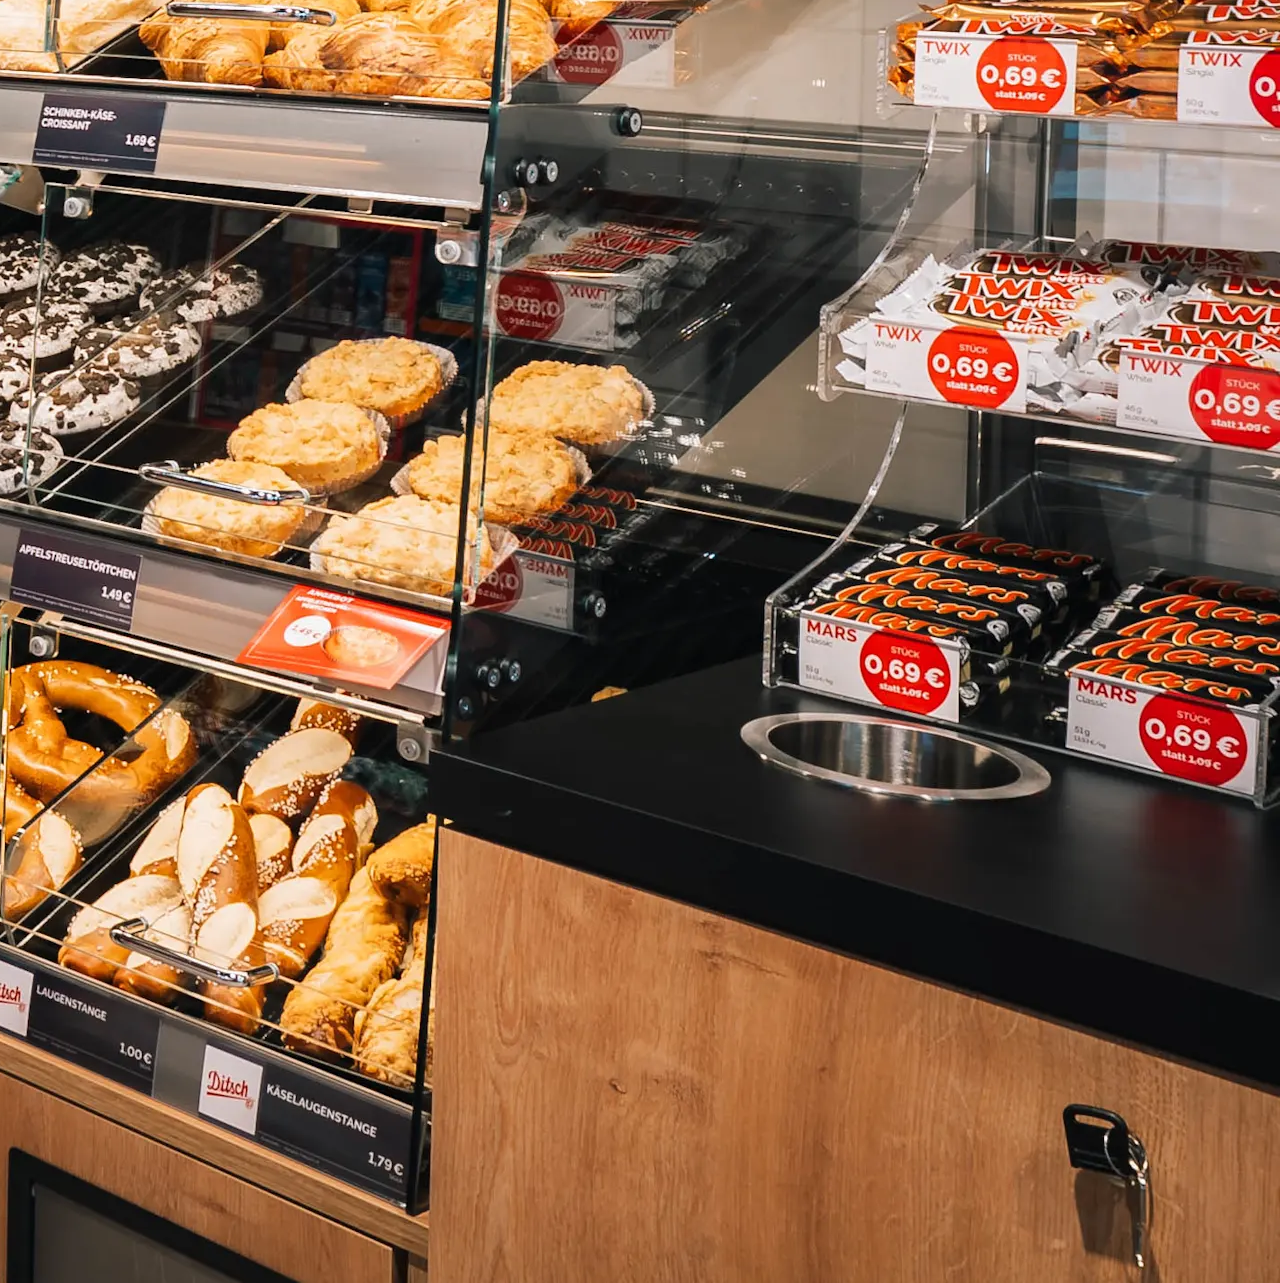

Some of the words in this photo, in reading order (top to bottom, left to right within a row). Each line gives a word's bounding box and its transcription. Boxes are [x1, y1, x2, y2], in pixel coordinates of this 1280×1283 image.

[923, 40, 971, 56] TWIX
[1007, 52, 1037, 63] STÜCK
[1187, 51, 1243, 67] TWIX
[980, 64, 1037, 88] 0,69
[1041, 68, 1061, 89] €
[1185, 67, 1214, 77] Single
[994, 91, 1017, 100] statt
[43, 106, 117, 122] SCHINKEN-KÄSE-
[41, 118, 91, 131] CROISSANT
[125, 133, 147, 146] 1,69
[147, 136, 157, 147] €
[874, 324, 923, 343] TWIX
[958, 343, 989, 355] STÜCK
[932, 353, 989, 379] 0,69
[992, 362, 1013, 382] €
[1127, 356, 1183, 377] TWIX
[946, 380, 968, 391] statt
[1125, 373, 1153, 383] White
[1225, 378, 1261, 391] STÜCK
[1194, 388, 1261, 417] 0,69
[1265, 399, 1280, 421] €
[1211, 418, 1237, 430] statt
[931, 531, 1094, 567] Mars
[19, 544, 137, 581] APFELSTREUSELTÖRTCHEN
[896, 549, 1058, 580] Mars
[865, 566, 1029, 604] Mars
[101, 586, 122, 601] 1,49
[123, 591, 132, 604] €
[306, 589, 354, 605] ANGEBOT
[835, 583, 999, 621] Mars
[807, 620, 857, 643] MARS
[805, 635, 833, 648] Classic
[890, 645, 920, 659] STÜCK
[1092, 637, 1279, 675] Mars
[864, 653, 921, 683] 0,69
[924, 667, 945, 689] €
[879, 683, 902, 694] statt
[1077, 677, 1137, 704] MARS
[1075, 694, 1108, 709] Classic
[1176, 709, 1212, 726] STÜCK
[1144, 717, 1211, 752] 0,69
[1216, 736, 1241, 759] €
[1160, 749, 1188, 763] statt
[1188, 755, 1212, 768] 1,09
[1212, 761, 1222, 770] €
[36, 984, 107, 1022] LAUGENSTANGE
[119, 1042, 142, 1061] 1,00
[143, 1053, 152, 1065] €
[206, 1070, 249, 1098] Ditsch
[266, 1083, 378, 1138] KÄSELAUGENSTANGE
[368, 1151, 392, 1172] 1,79
[394, 1163, 404, 1176] €
